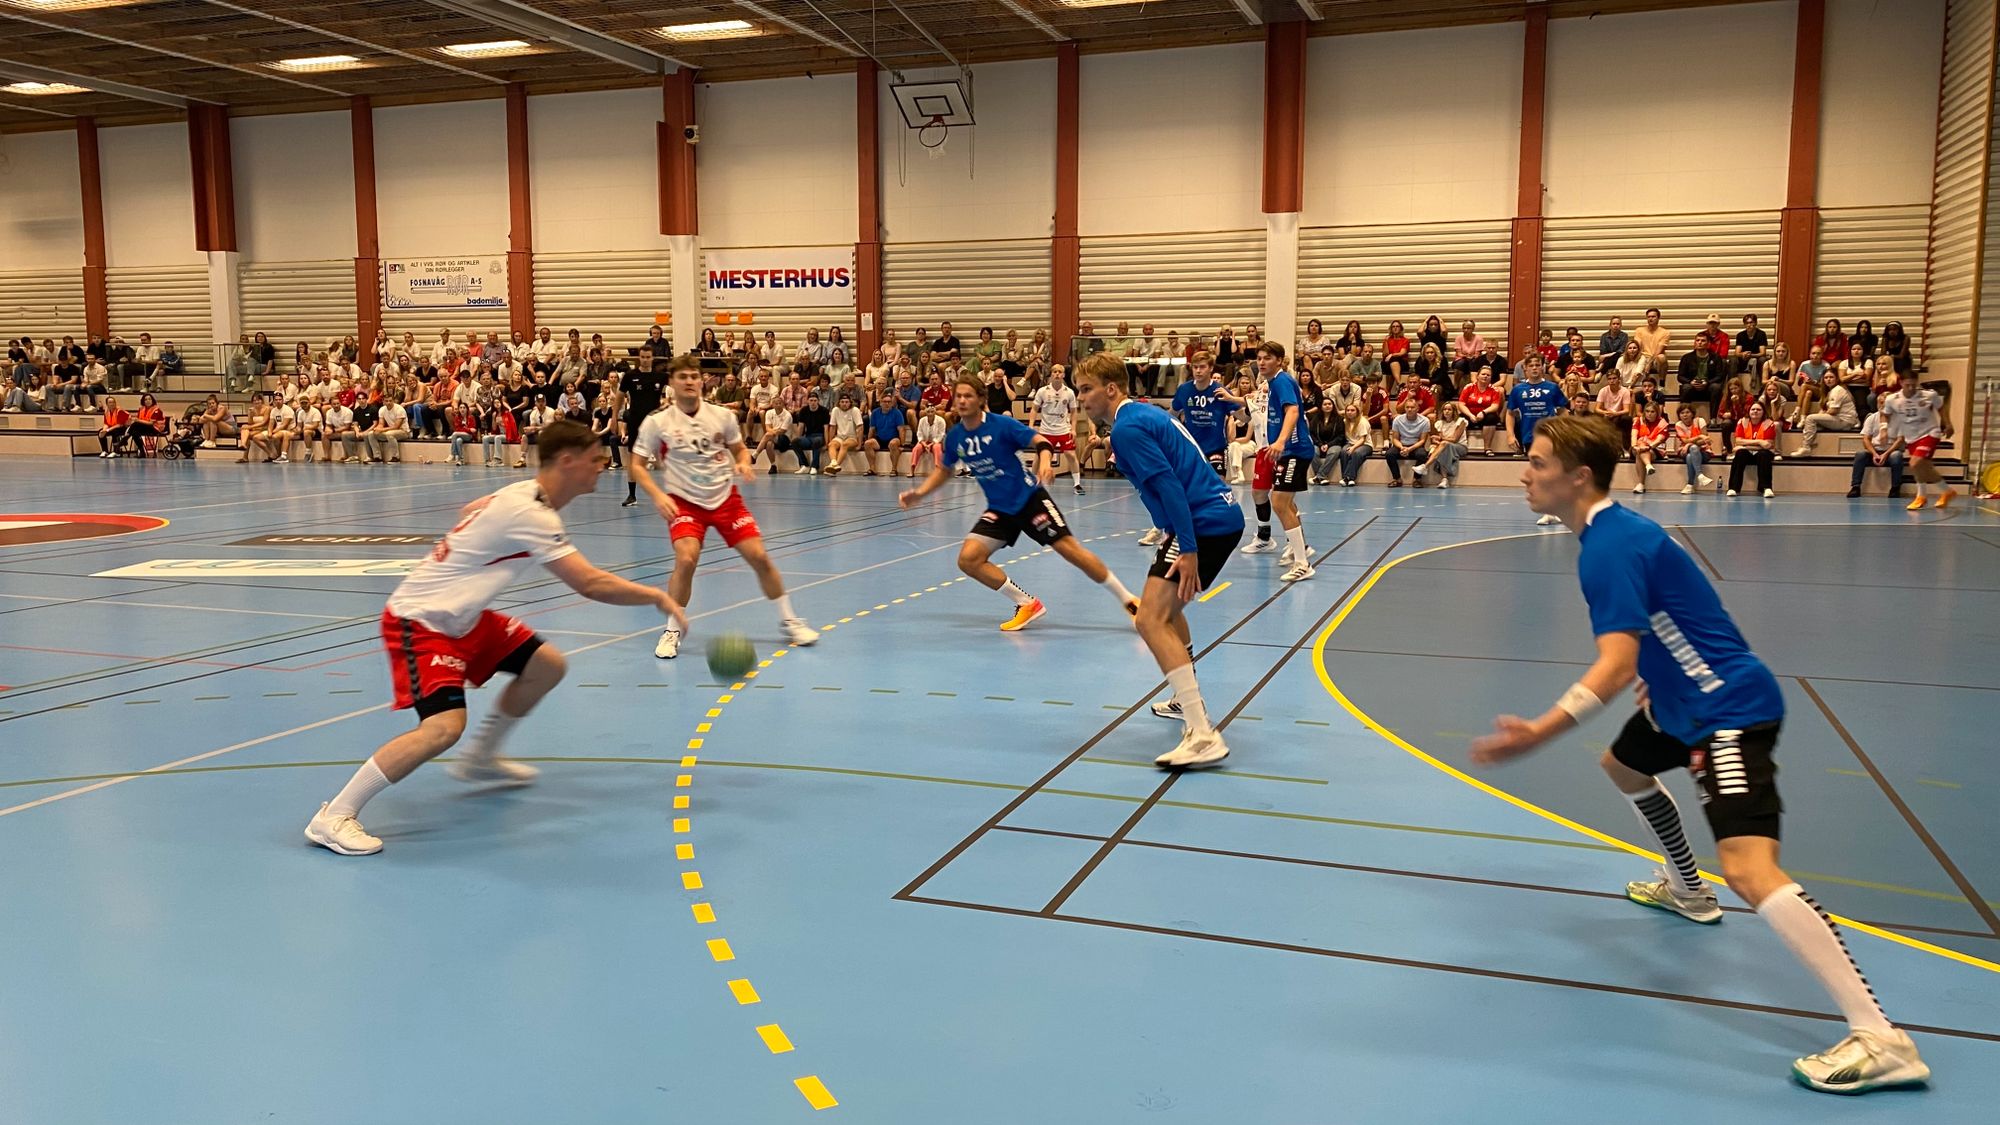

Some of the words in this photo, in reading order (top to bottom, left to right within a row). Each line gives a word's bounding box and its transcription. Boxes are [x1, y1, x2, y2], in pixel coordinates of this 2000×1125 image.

[410, 275, 445, 286] FOSNAVÅG
[709, 267, 850, 289] MESTERHUS
[1529, 388, 1542, 398] 36
[1054, 400, 1059, 408] 7
[1194, 395, 1207, 408] 20
[965, 435, 983, 456] 21
